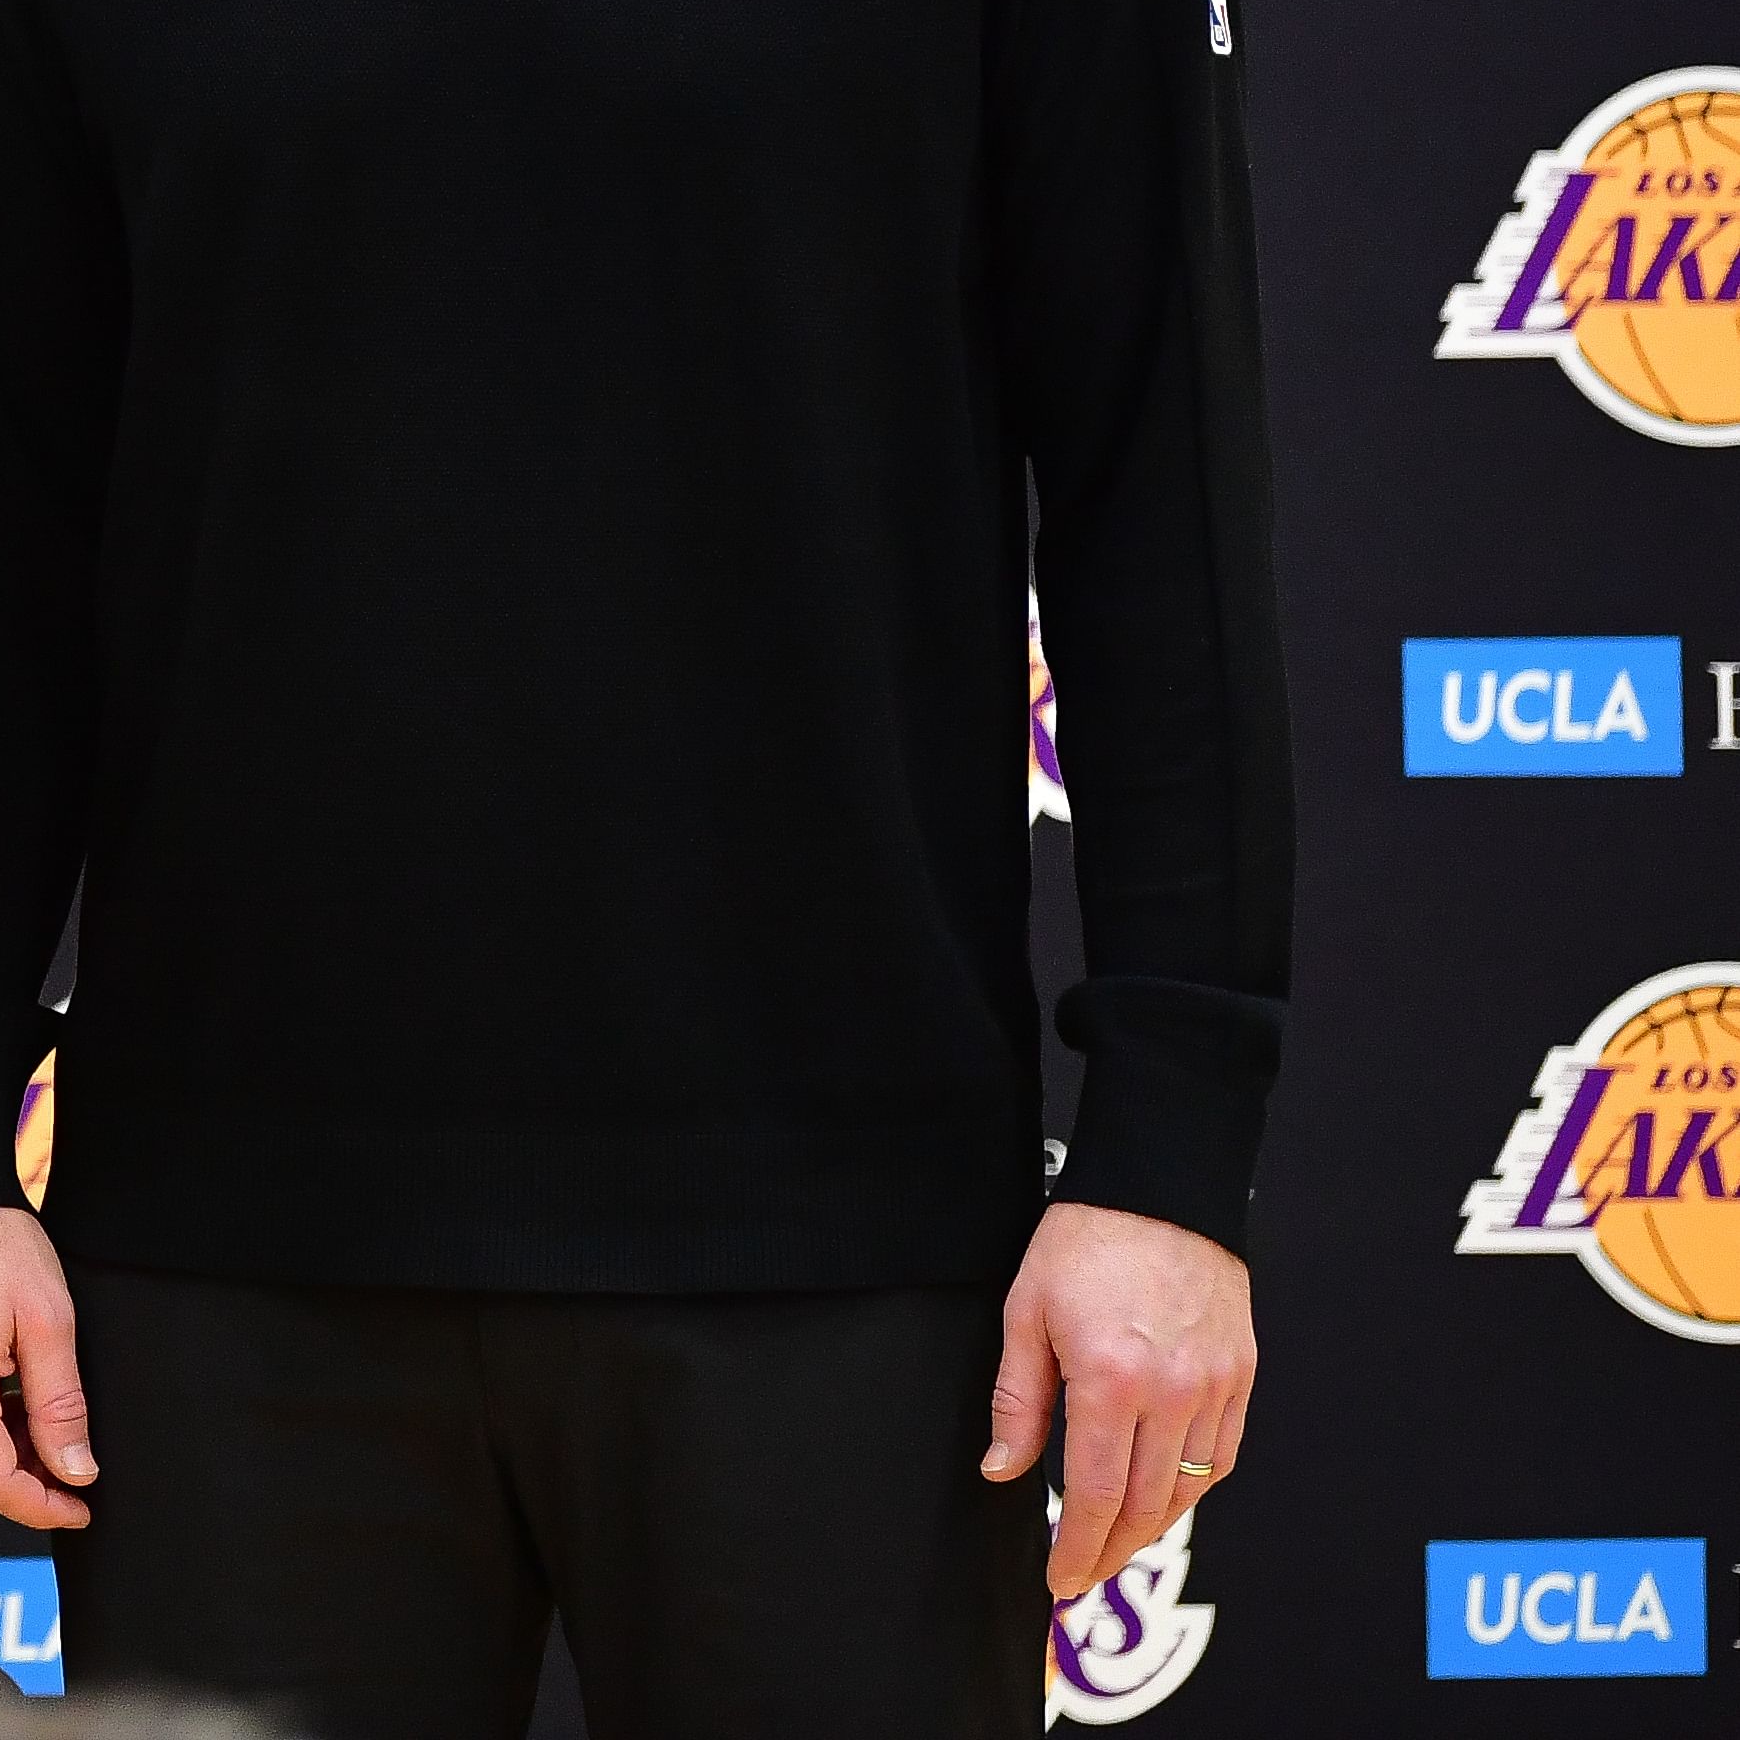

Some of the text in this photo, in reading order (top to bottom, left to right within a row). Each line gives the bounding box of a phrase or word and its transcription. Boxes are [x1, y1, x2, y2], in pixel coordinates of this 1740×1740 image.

[1634, 169, 1723, 198] LOS
[1466, 168, 1740, 337] LAK
[1442, 667, 1649, 745] UCLA
[1649, 1063, 1739, 1093] LOS
[1484, 1063, 1740, 1233] LAK
[1465, 1571, 1672, 1647] UCLA
